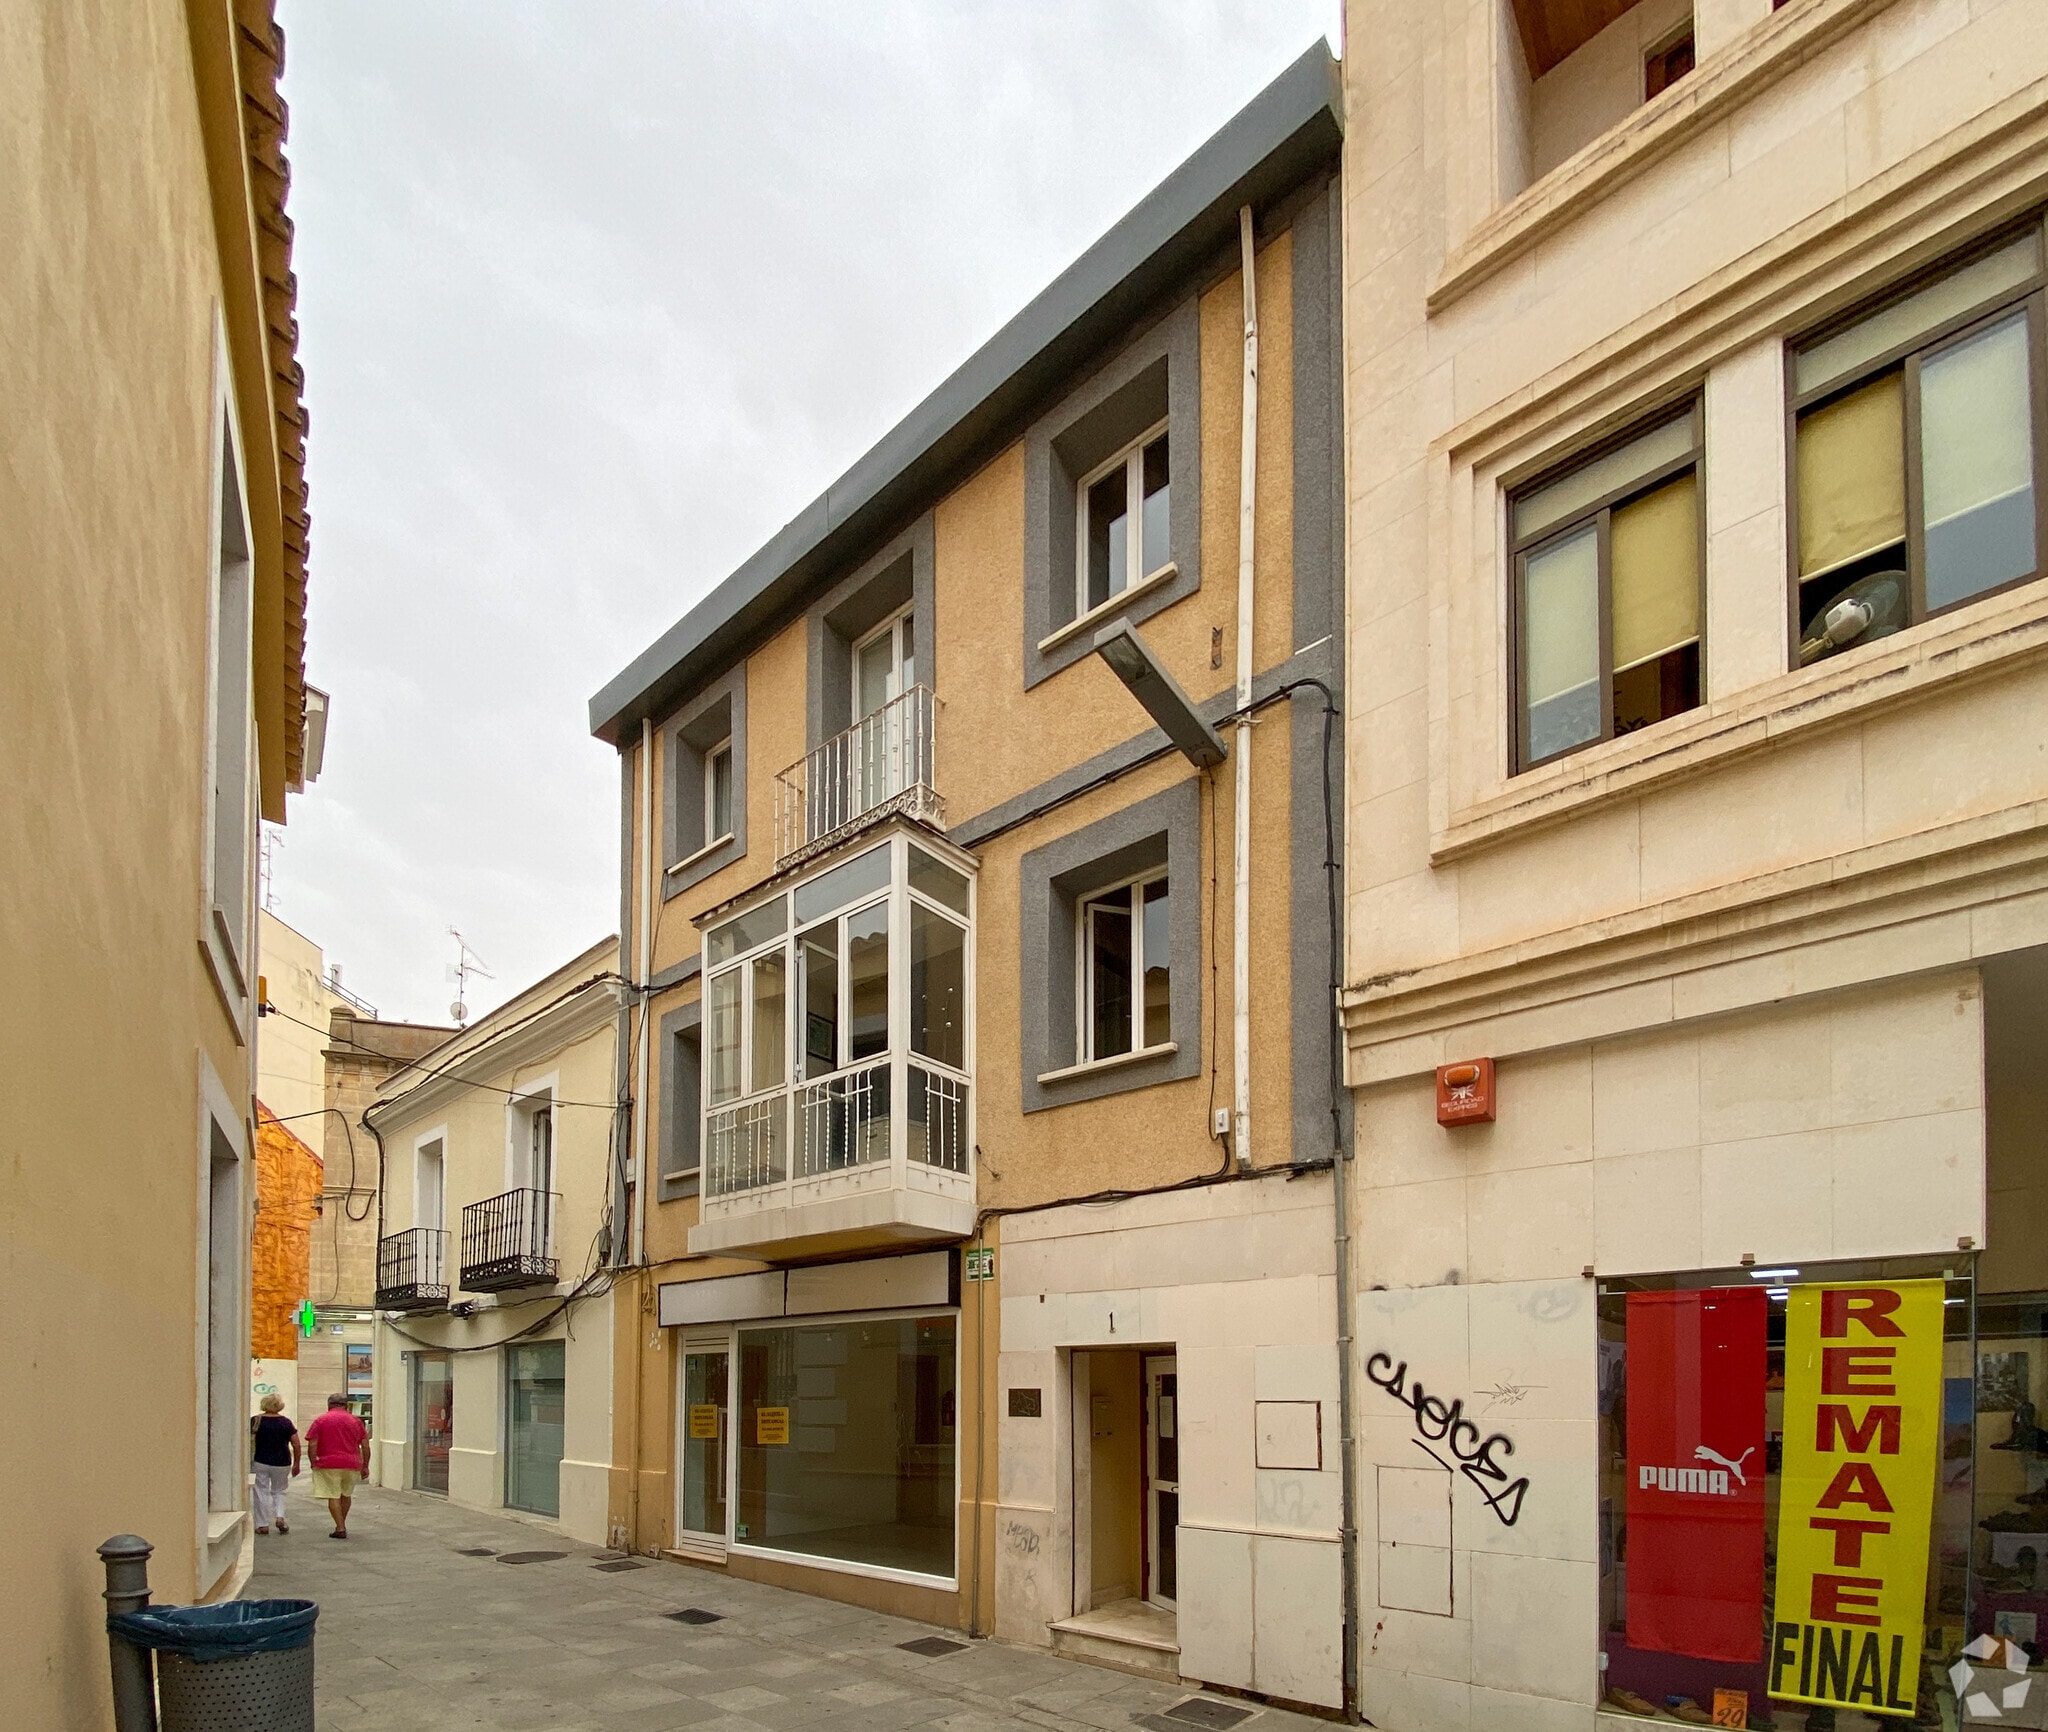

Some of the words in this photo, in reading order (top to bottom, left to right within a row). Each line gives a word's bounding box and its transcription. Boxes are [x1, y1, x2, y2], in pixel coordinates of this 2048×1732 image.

[1109, 1311, 1116, 1334] 1
[1640, 1466, 1728, 1494] PUMA
[1809, 1289, 1907, 1627] REMATE
[1771, 1622, 1913, 1710] FINAL
